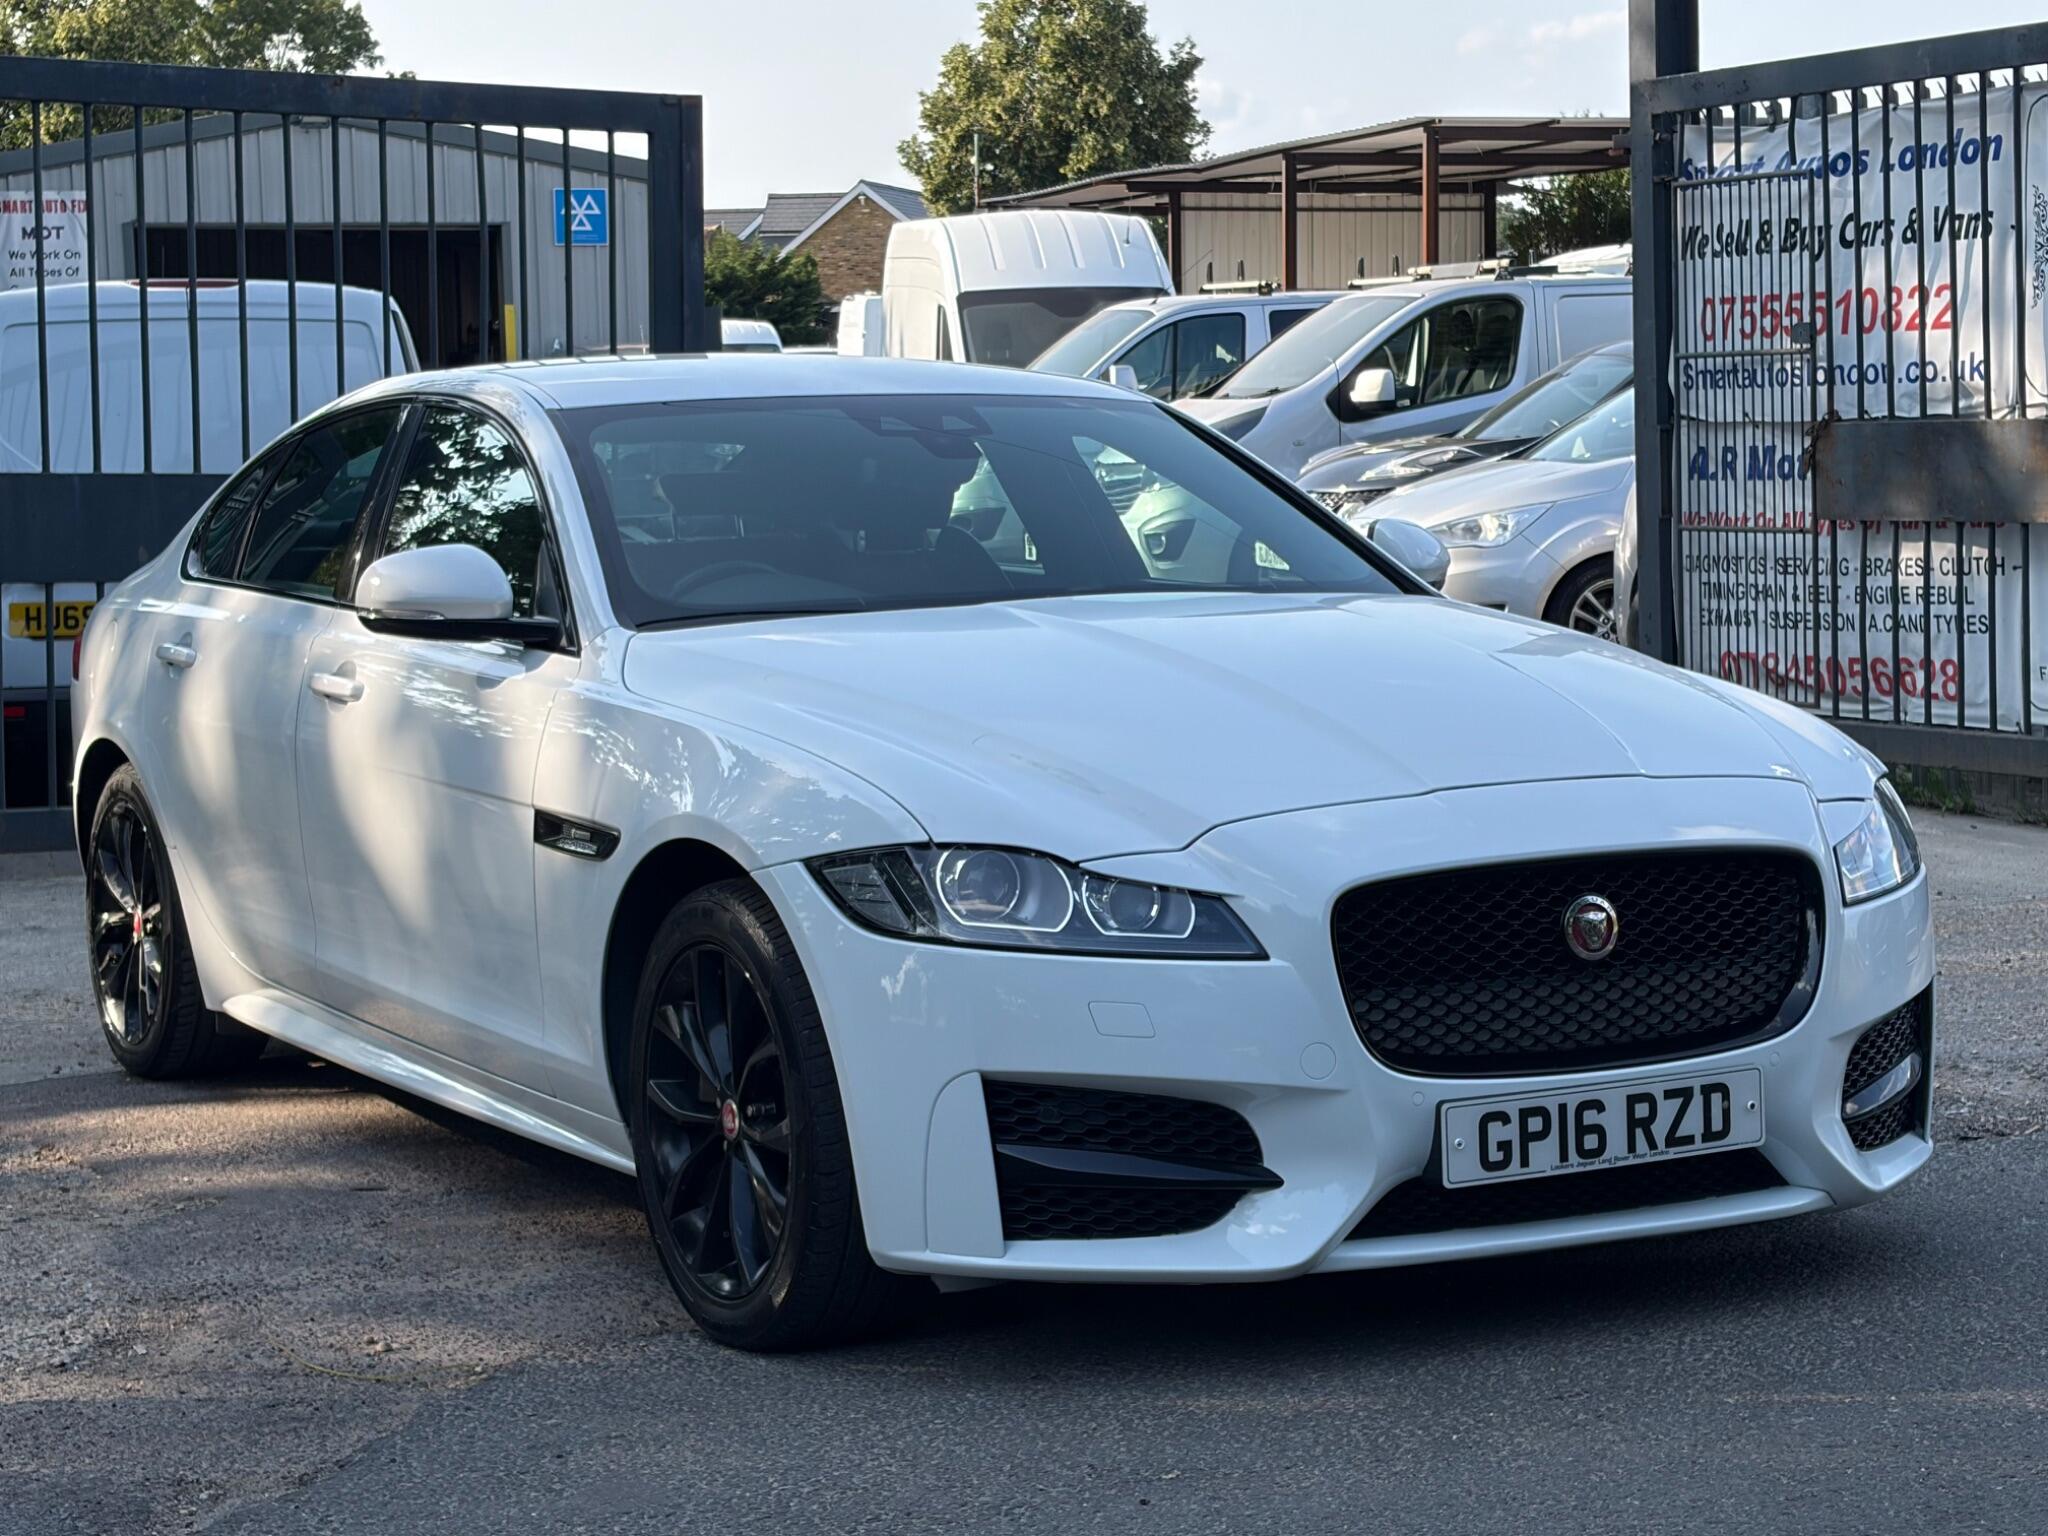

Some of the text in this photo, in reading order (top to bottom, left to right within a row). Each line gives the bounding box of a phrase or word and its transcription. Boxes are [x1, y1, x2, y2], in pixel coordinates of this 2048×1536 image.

[0, 199, 33, 214] MART
[21, 226, 64, 240] MOT
[1681, 225, 1710, 261] We
[1713, 219, 1751, 258] Sell
[1780, 217, 1833, 263] Buy
[1839, 212, 1895, 249] Cars
[1901, 207, 1920, 244] &
[1933, 205, 1994, 242] Vans
[8, 250, 26, 260] We
[64, 249, 81, 260] On
[10, 266, 79, 278] All Tpes Of
[1700, 284, 1955, 342] 07555510822
[1747, 445, 1812, 481] Mot
[1685, 555, 1766, 575] DIAGNOSTCS
[1777, 557, 1849, 577] SERVCIG
[1865, 557, 1924, 577] BRAKES
[1939, 556, 2005, 577] CLUTCH
[1749, 584, 1787, 602] CHAN
[1855, 586, 1911, 605] ENGIE
[1916, 586, 1974, 605] REBUL
[1769, 611, 1856, 632] SUSPENSON
[1478, 1082, 1731, 1172] GP16 RZD
